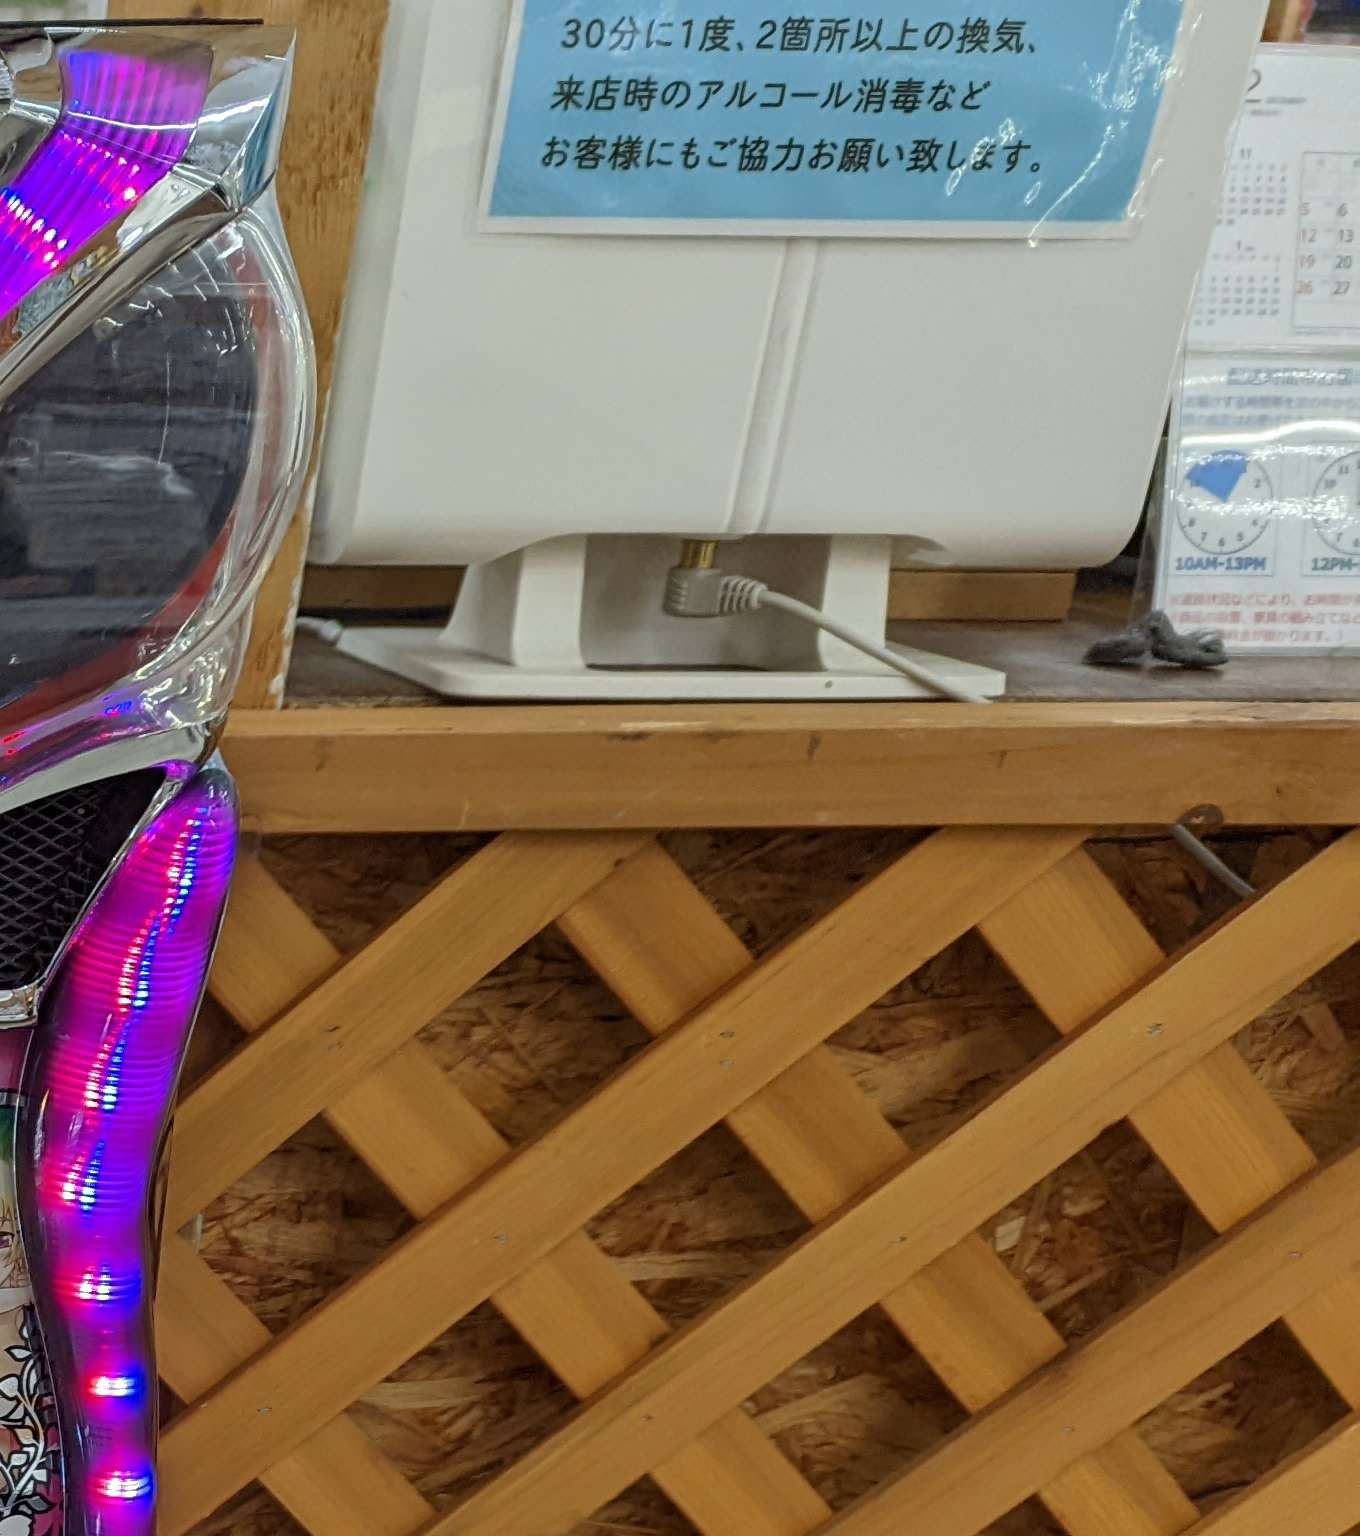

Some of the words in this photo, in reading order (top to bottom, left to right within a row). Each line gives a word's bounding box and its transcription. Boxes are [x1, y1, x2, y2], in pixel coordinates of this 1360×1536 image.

[561, 16, 1037, 54] 30分に1度、2箇所以上の換気、
[550, 78, 991, 114] 来店時のアルコール消毒など
[541, 136, 1043, 174] お客様にもご協力お願い致します。
